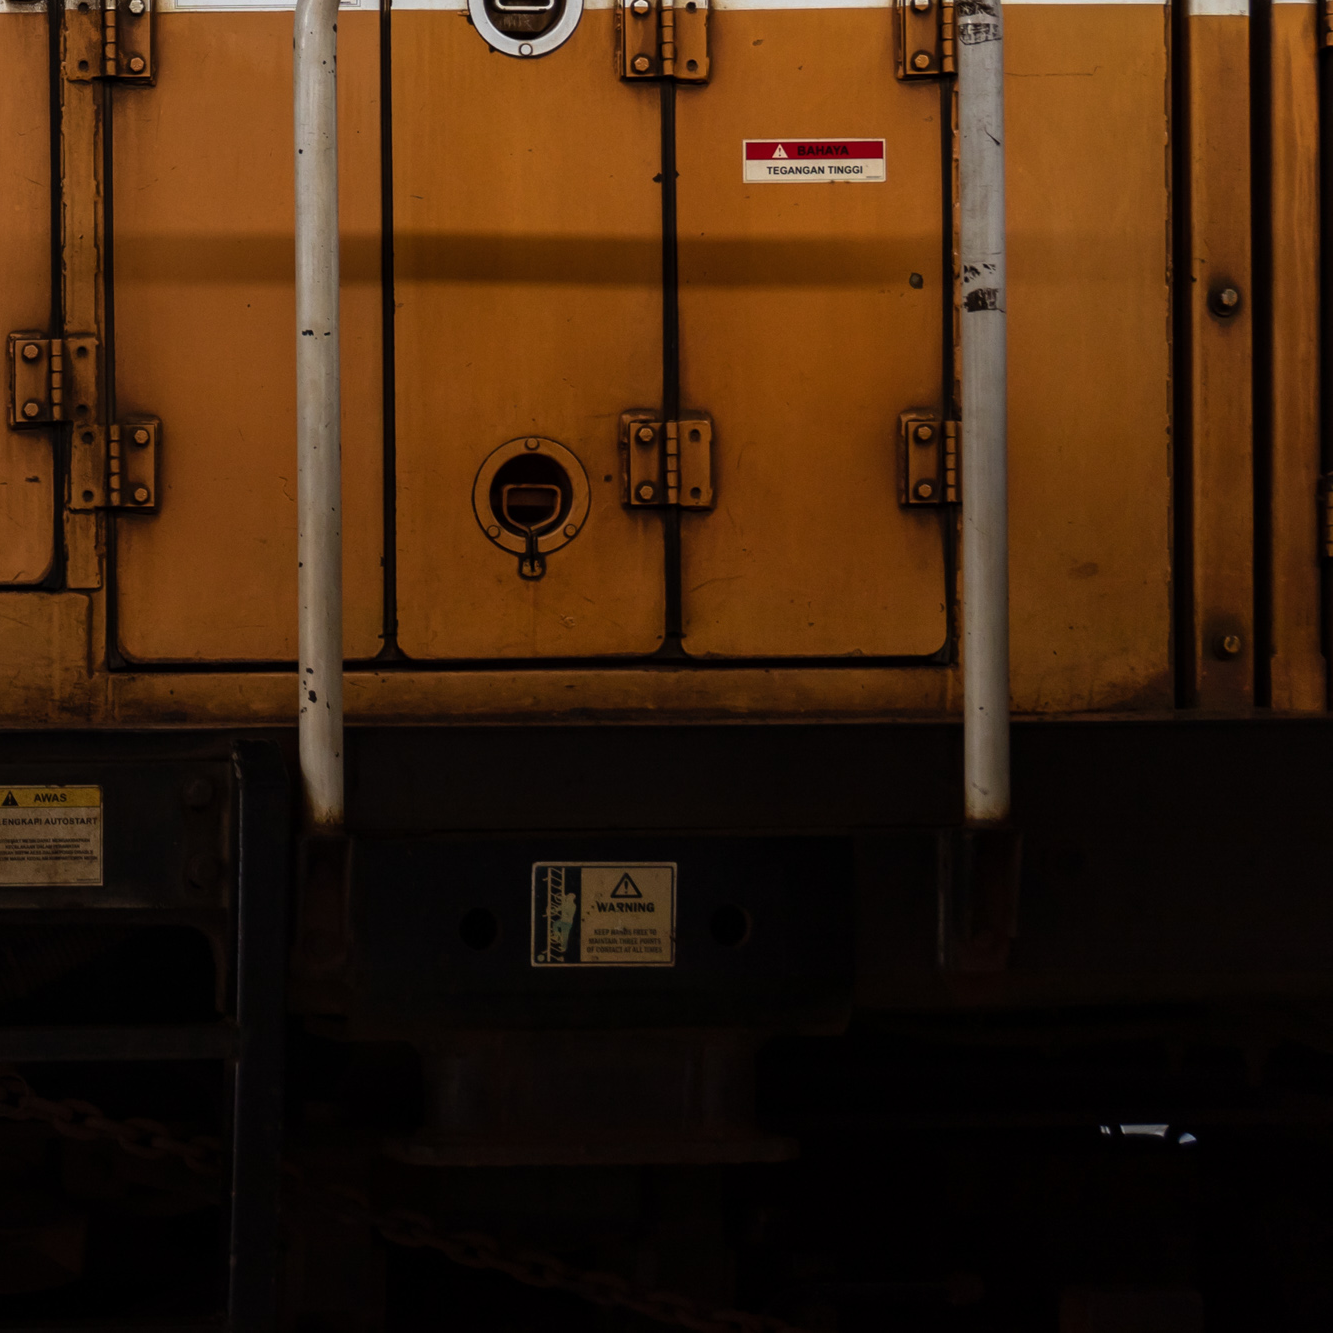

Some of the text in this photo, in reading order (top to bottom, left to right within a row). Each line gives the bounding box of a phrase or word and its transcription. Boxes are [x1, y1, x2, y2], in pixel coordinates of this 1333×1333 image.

[797, 145, 849, 156] BAHAYA
[767, 165, 863, 175] TEGANGAN TINGGI
[33, 793, 67, 803] AWAS
[45, 817, 98, 826] AUTOSTART
[596, 902, 655, 913] WARNING
